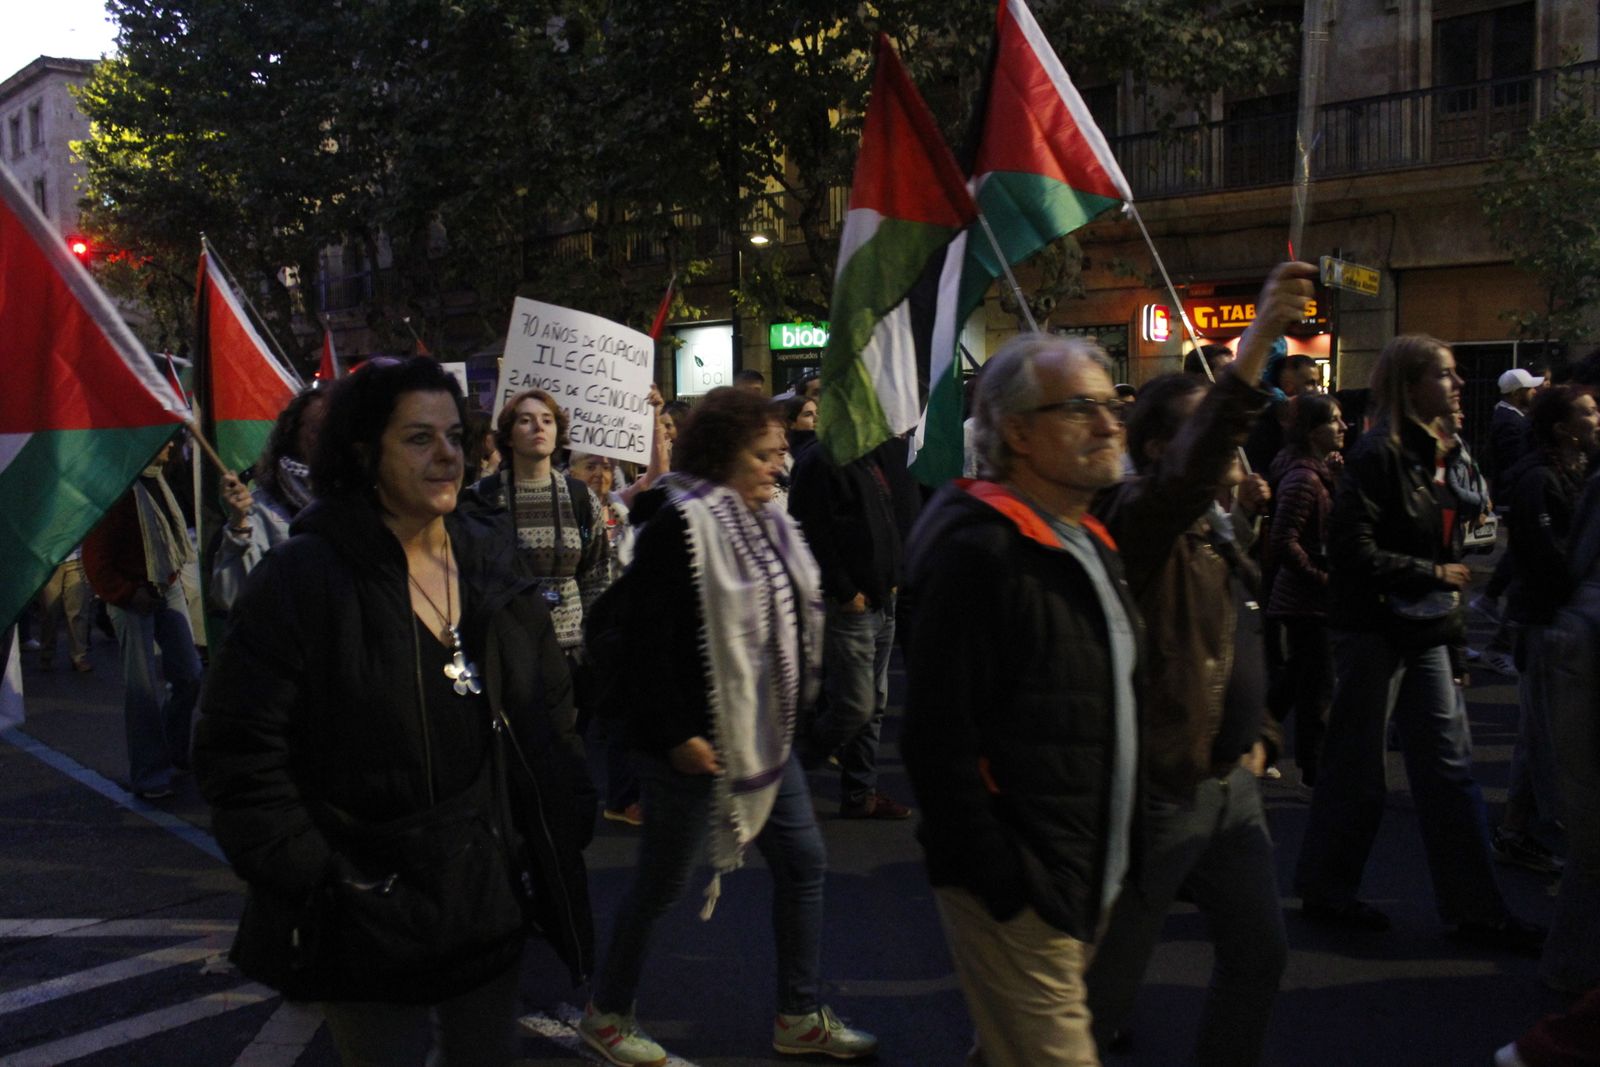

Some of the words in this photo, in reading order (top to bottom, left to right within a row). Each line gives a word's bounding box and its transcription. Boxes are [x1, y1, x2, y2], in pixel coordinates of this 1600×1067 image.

[1219, 299, 1318, 322] TABS
[521, 312, 540, 337] 70
[541, 322, 579, 344] AÑOS
[532, 343, 623, 382] ILEGAL
[508, 369, 520, 386] 2
[569, 424, 646, 453] ENOCIDAS
